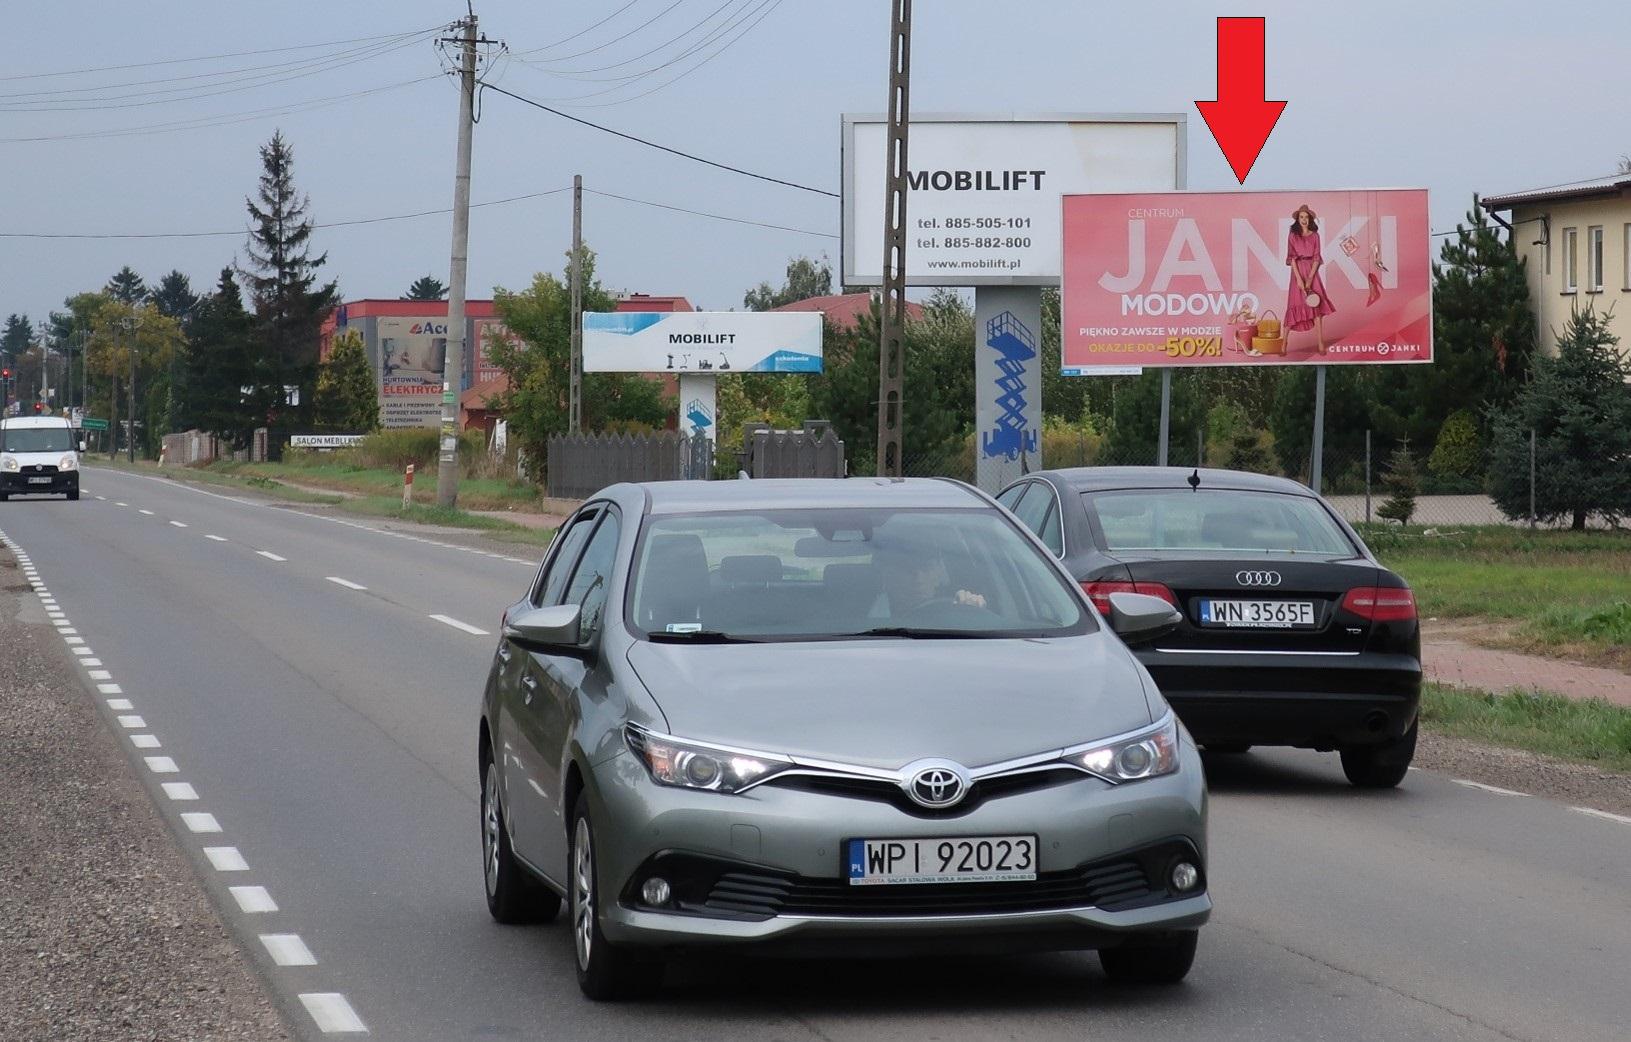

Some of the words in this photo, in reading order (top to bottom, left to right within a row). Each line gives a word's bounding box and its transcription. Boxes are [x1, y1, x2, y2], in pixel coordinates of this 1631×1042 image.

[906, 170, 1046, 191] MOBILIFT
[1128, 207, 1185, 219] CENTRUM
[917, 217, 941, 229] tel.
[945, 217, 1031, 229] 885-505-101
[917, 237, 940, 249] tel.
[944, 237, 1031, 249] 885-882-800
[1097, 215, 1398, 293] JANKI
[927, 258, 1021, 270] www.mobilift.pl
[1121, 292, 1259, 317] MODOWO
[1079, 327, 1119, 338] PIĘKNO
[1121, 326, 1165, 336] ZAWSZE
[1167, 326, 1179, 336] W
[1181, 325, 1222, 336] MODZIE
[668, 333, 736, 344] MOBILIFT
[1088, 343, 1135, 353] OKAZJE
[1136, 343, 1155, 353] DO
[1157, 336, 1222, 358] -50%!
[1328, 345, 1376, 353] CENTRUM
[1390, 344, 1421, 353] JANKI
[296, 437, 323, 445] SALON
[1213, 602, 1243, 621] WN
[1250, 602, 1311, 622] 3565F
[867, 842, 920, 875] WPI
[937, 840, 1032, 873] 92023
[851, 864, 863, 873] PL
